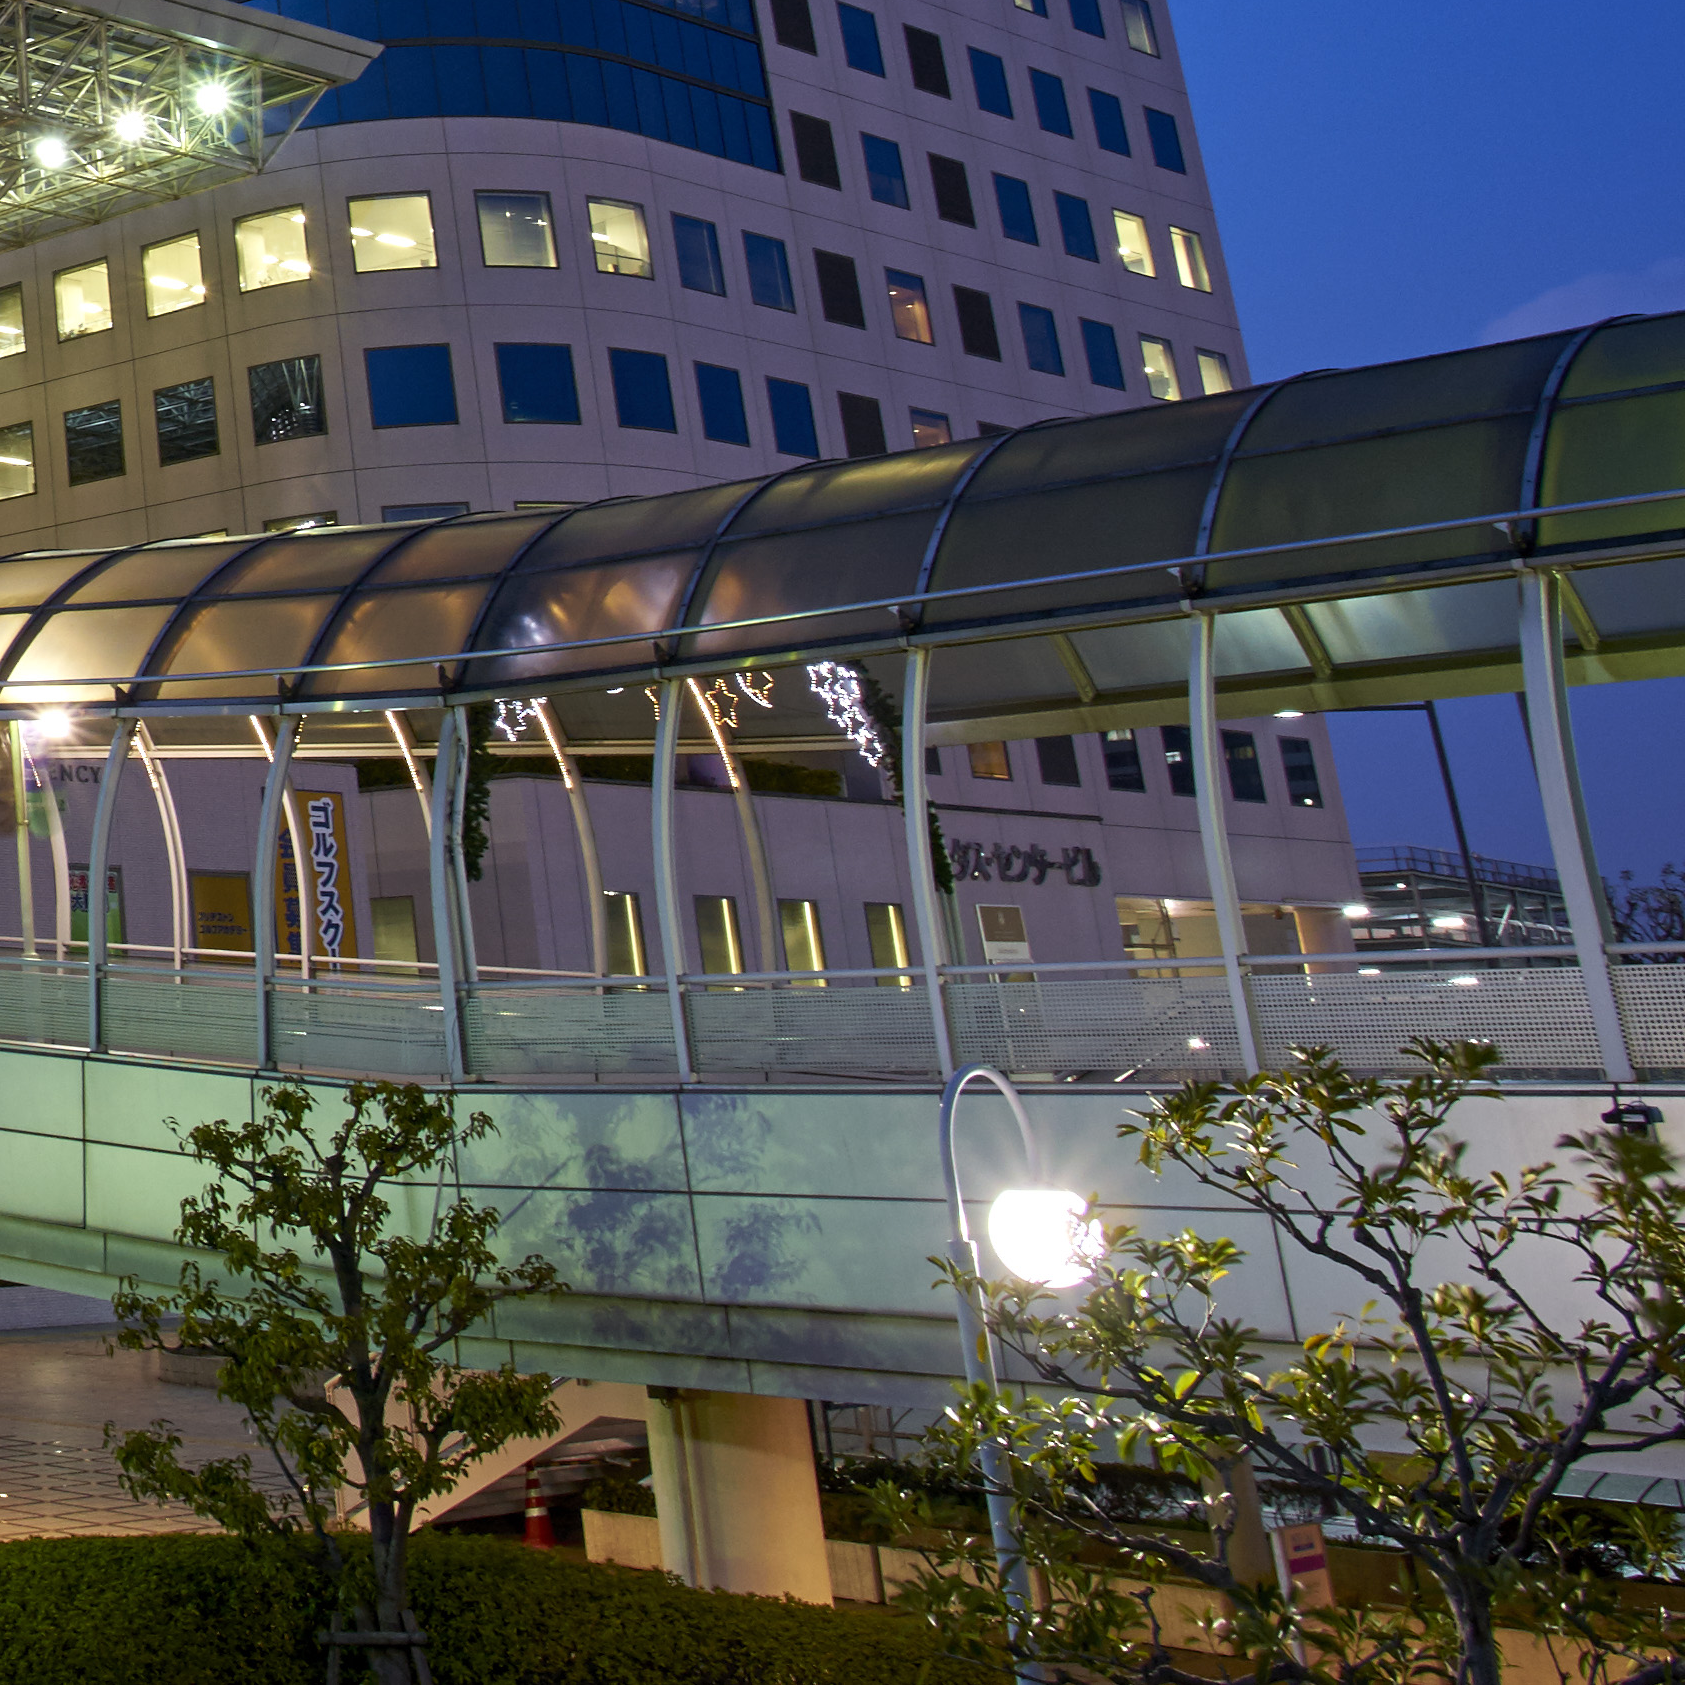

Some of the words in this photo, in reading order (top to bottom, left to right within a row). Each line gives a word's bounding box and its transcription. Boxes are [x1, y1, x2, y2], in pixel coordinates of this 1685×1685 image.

[309, 798, 343, 974] ゴルフスクー
